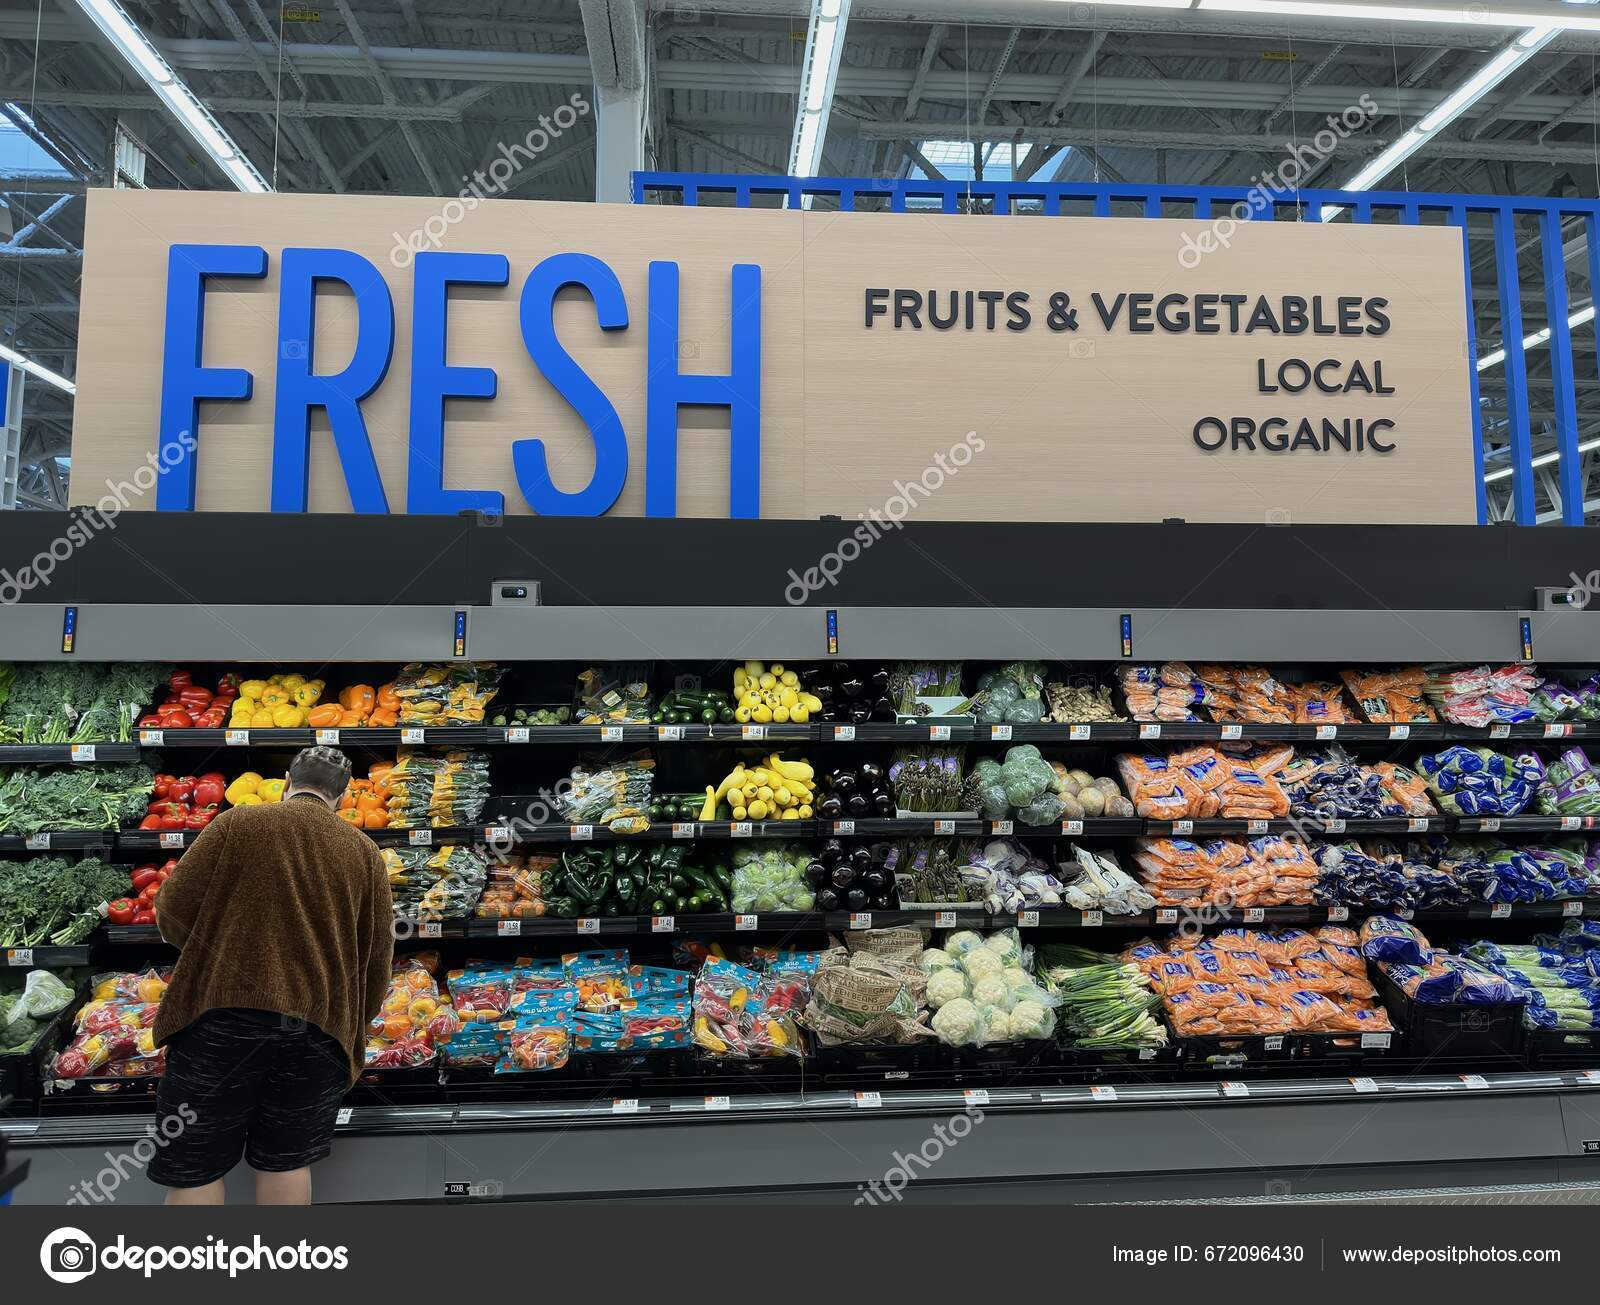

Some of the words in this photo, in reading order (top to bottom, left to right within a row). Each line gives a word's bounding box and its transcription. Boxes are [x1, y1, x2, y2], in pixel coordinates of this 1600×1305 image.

[864, 288, 1031, 333] FRUITS
[1046, 290, 1080, 333] &
[1091, 292, 1391, 336] VEGETABLES
[156, 243, 762, 520] FRESH
[1256, 357, 1396, 395] LOCAL
[1192, 415, 1397, 454] ORGANIC
